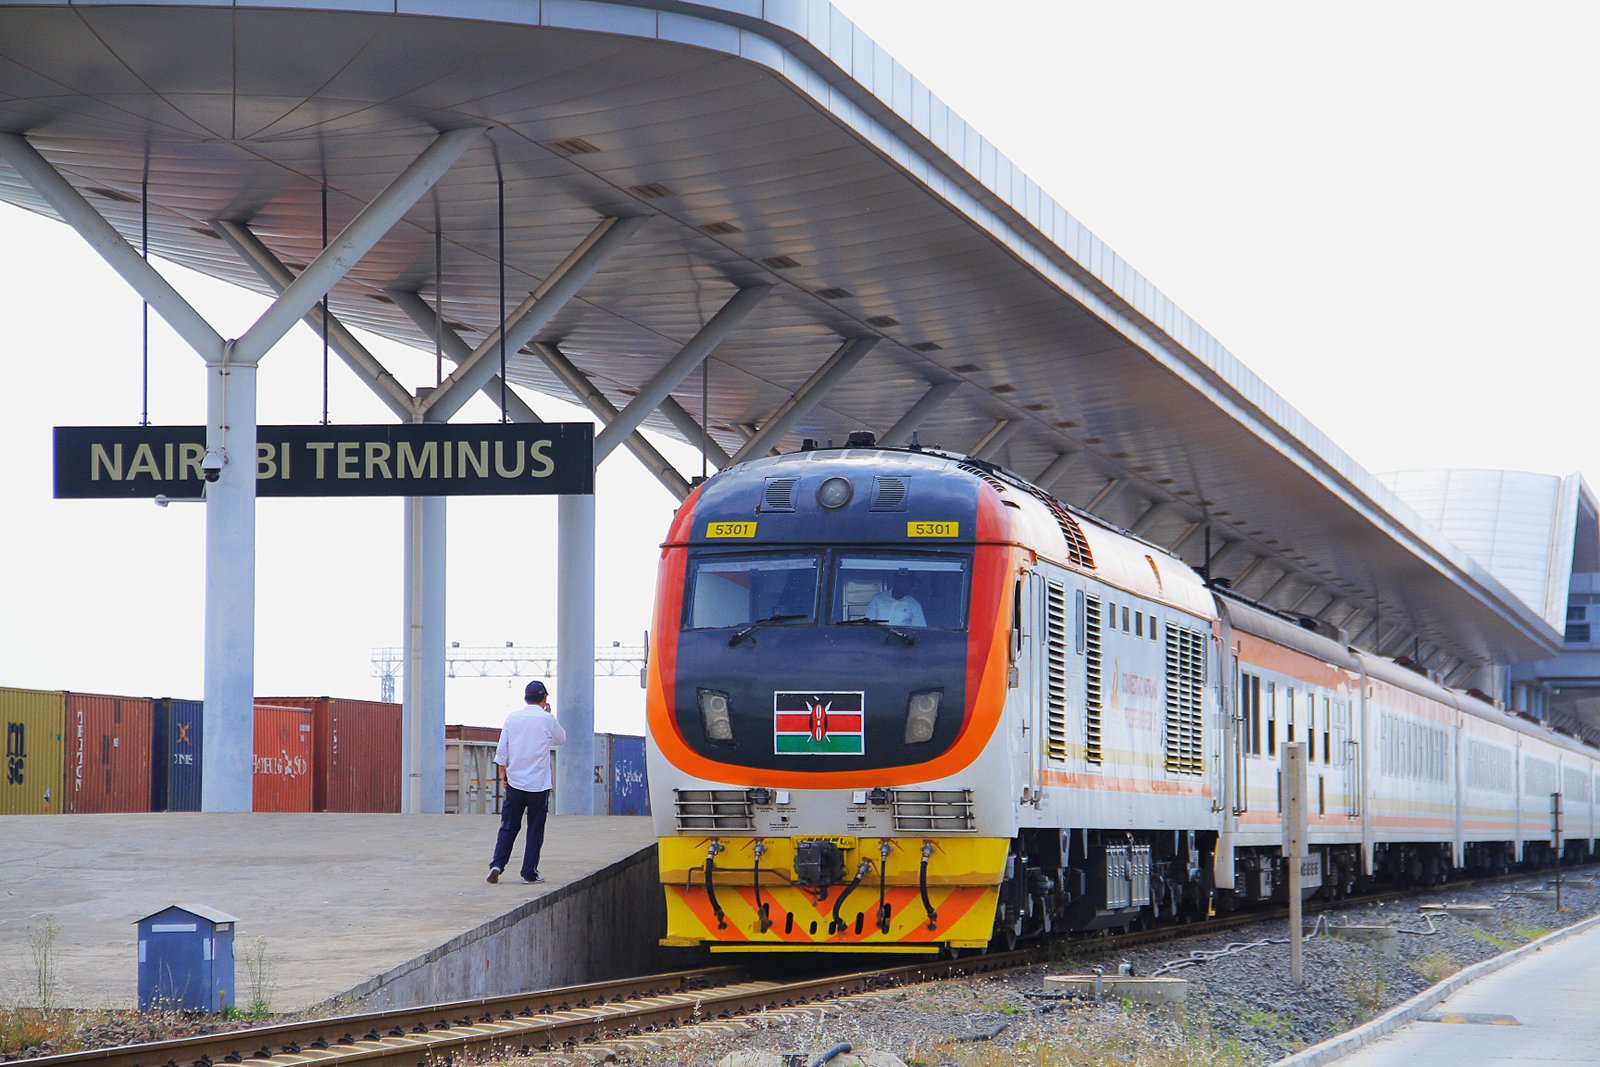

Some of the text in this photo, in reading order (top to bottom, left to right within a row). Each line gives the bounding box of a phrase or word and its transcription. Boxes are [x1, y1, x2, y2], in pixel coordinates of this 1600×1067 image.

[91, 440, 555, 481] NAIRBI TERMINUS
[716, 524, 748, 536] 5301
[916, 524, 950, 536] 5301
